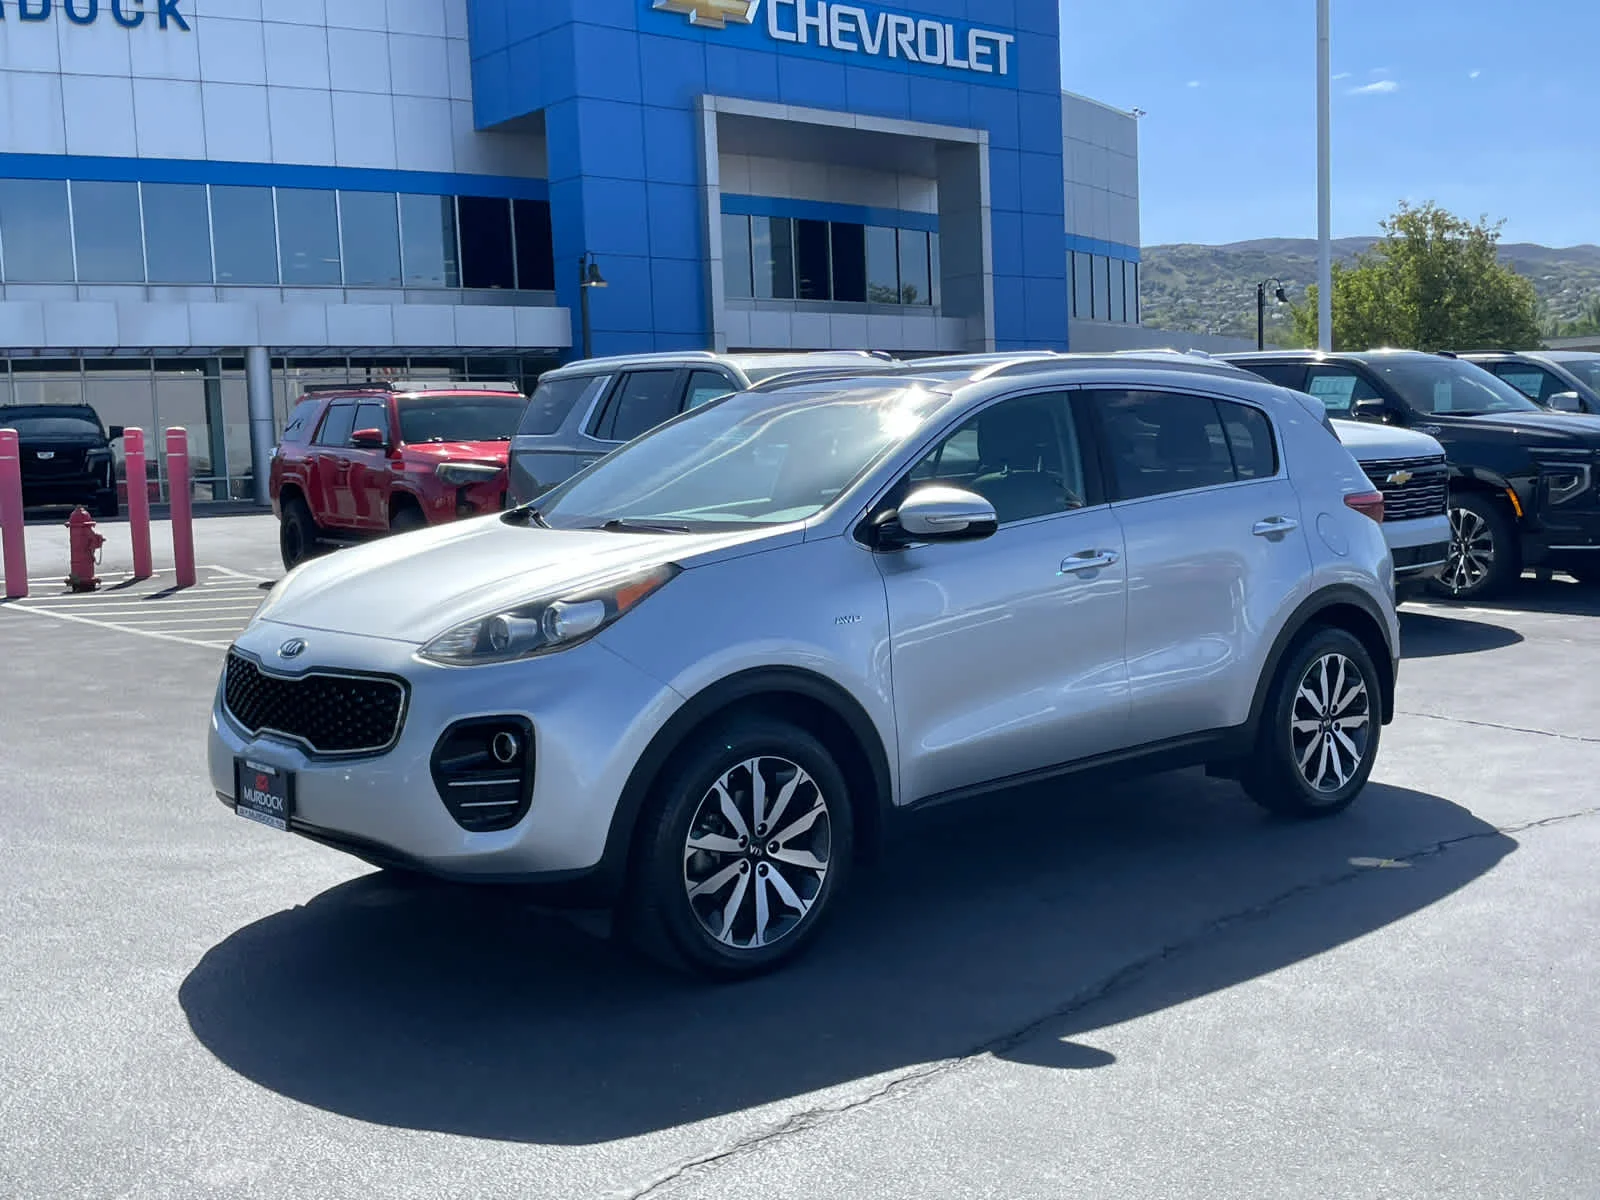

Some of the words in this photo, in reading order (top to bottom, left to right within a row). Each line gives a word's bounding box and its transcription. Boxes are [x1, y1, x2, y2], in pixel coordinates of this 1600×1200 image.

[0, 0, 191, 31] DOCK
[767, 0, 1015, 75] CHEVROLET
[243, 784, 284, 812] MURDOCK
